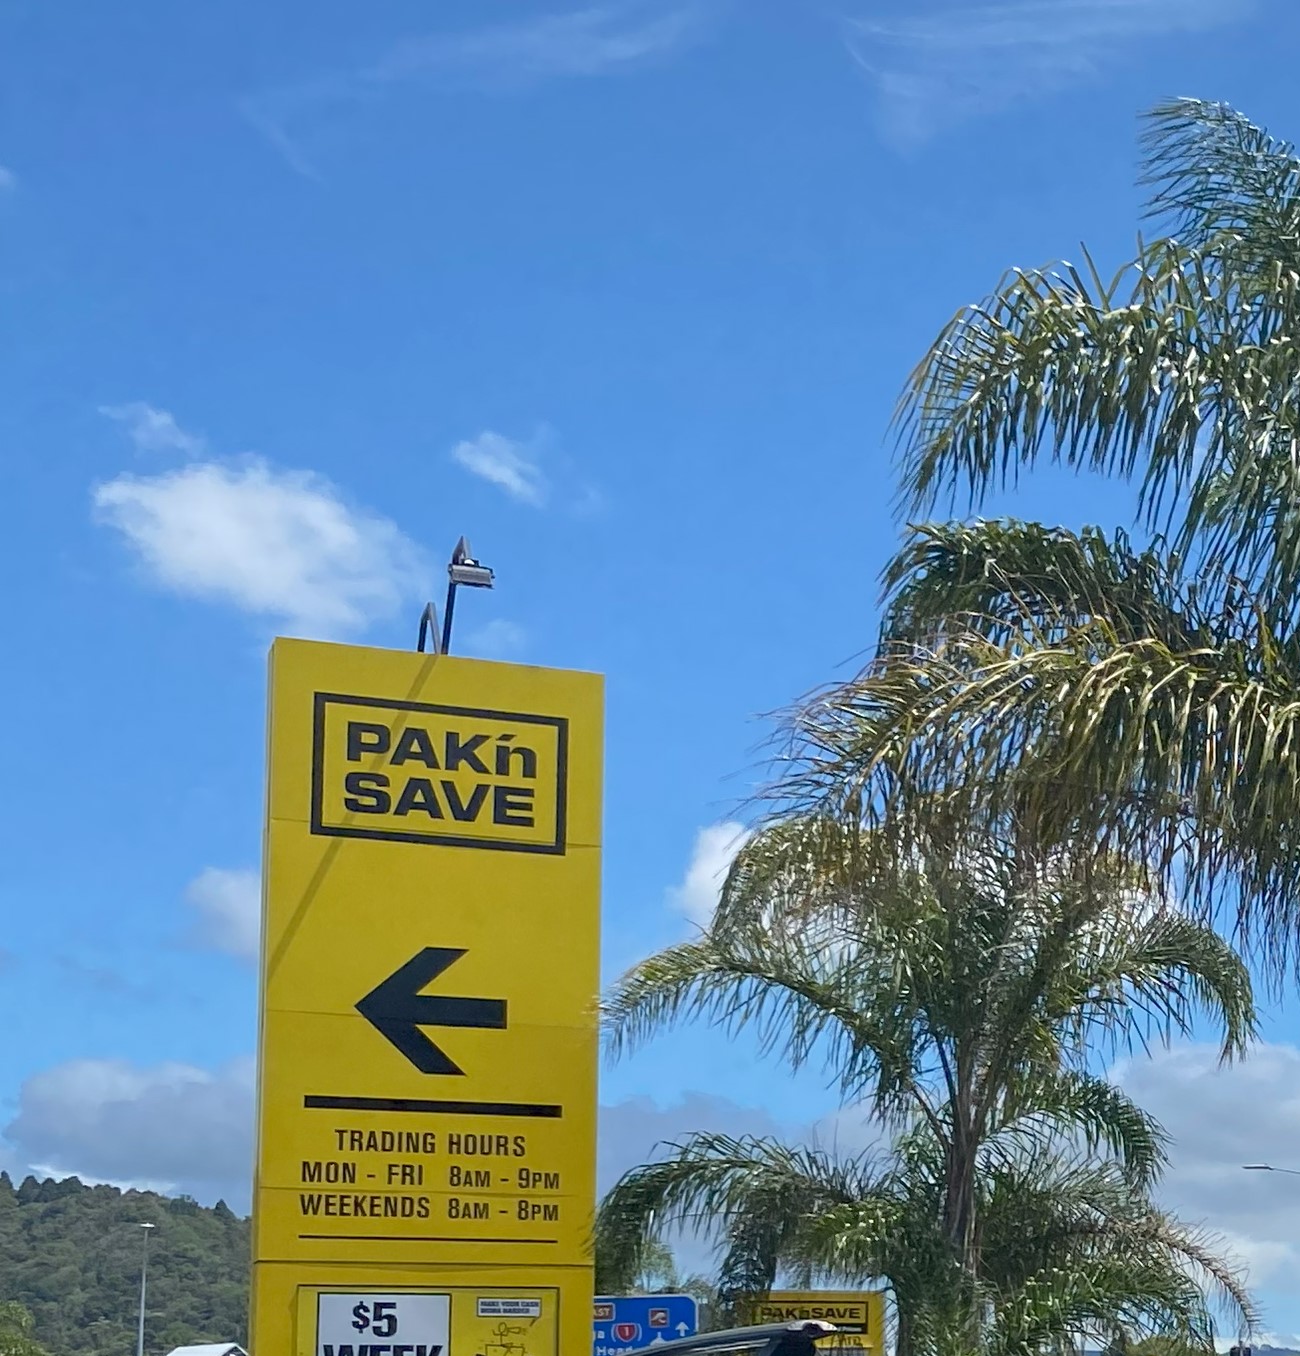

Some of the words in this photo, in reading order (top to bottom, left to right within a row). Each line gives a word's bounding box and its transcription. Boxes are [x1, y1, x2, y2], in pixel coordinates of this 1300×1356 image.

[344, 772, 536, 828] SAVE
[334, 1129, 437, 1155] TRADING
[448, 1133, 527, 1158] HOURS
[301, 1161, 357, 1185] MON
[387, 1163, 424, 1187] FRI
[448, 1166, 491, 1188] 8AM
[517, 1167, 560, 1190] 9PM
[300, 1194, 431, 1219] WEEKENDS
[447, 1198, 490, 1220] 8AM
[517, 1200, 559, 1222] 8PM
[351, 1301, 398, 1337] $5
[623, 1326, 630, 1337] 1
